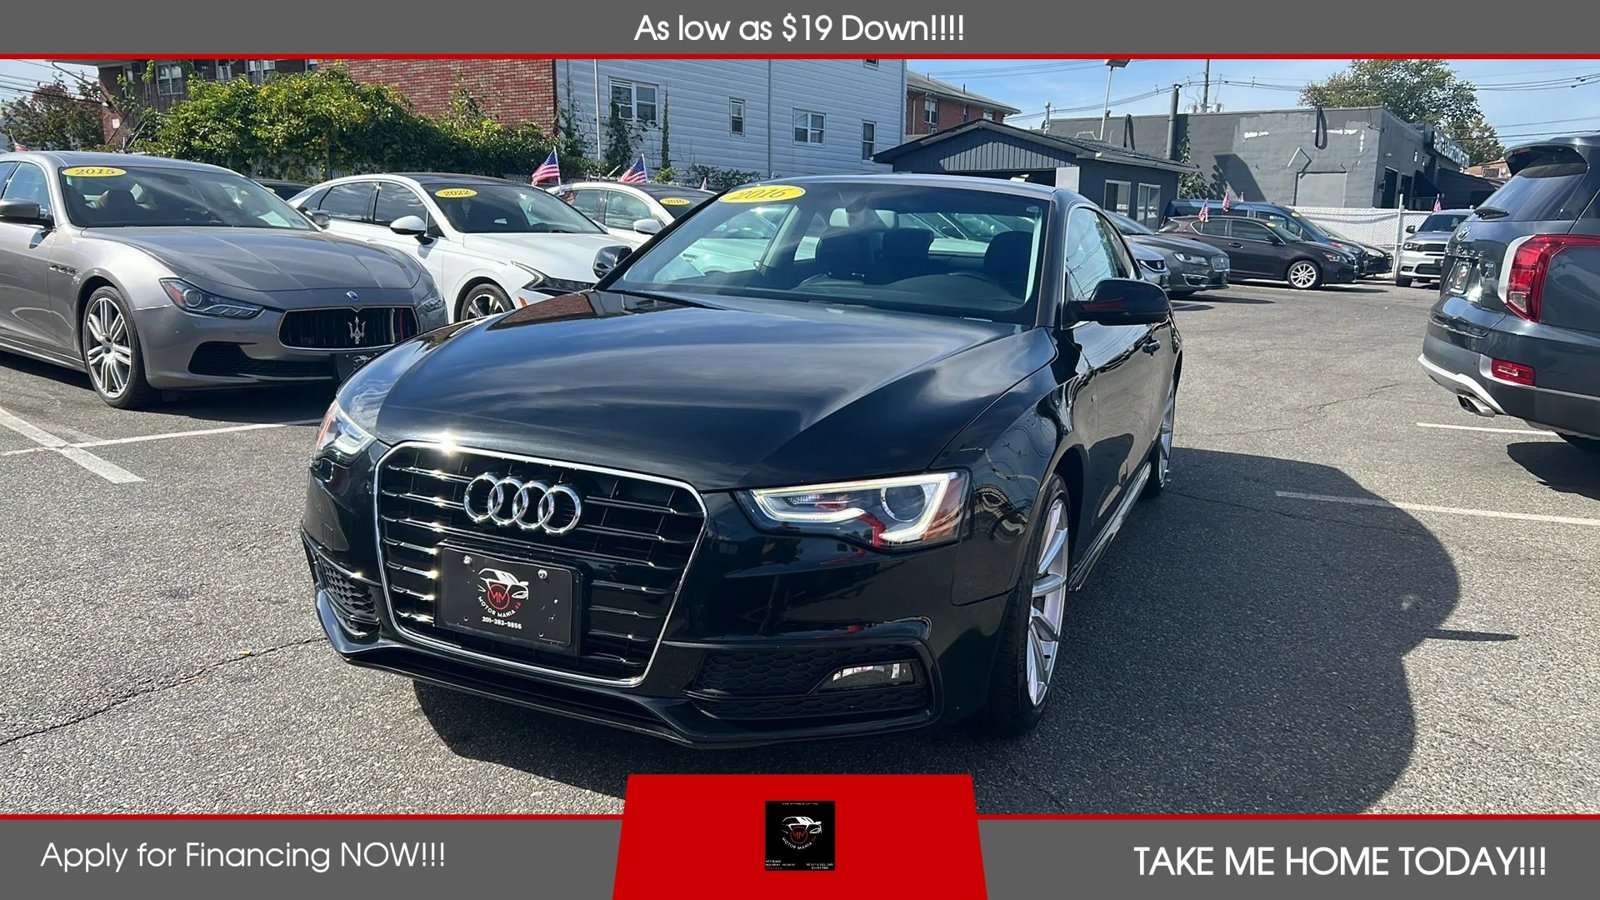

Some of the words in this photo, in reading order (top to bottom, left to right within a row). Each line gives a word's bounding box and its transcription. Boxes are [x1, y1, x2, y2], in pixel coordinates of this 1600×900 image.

[729, 188, 789, 200] 2016
[478, 596, 496, 615] MOTOR
[497, 609, 516, 618] MANIA
